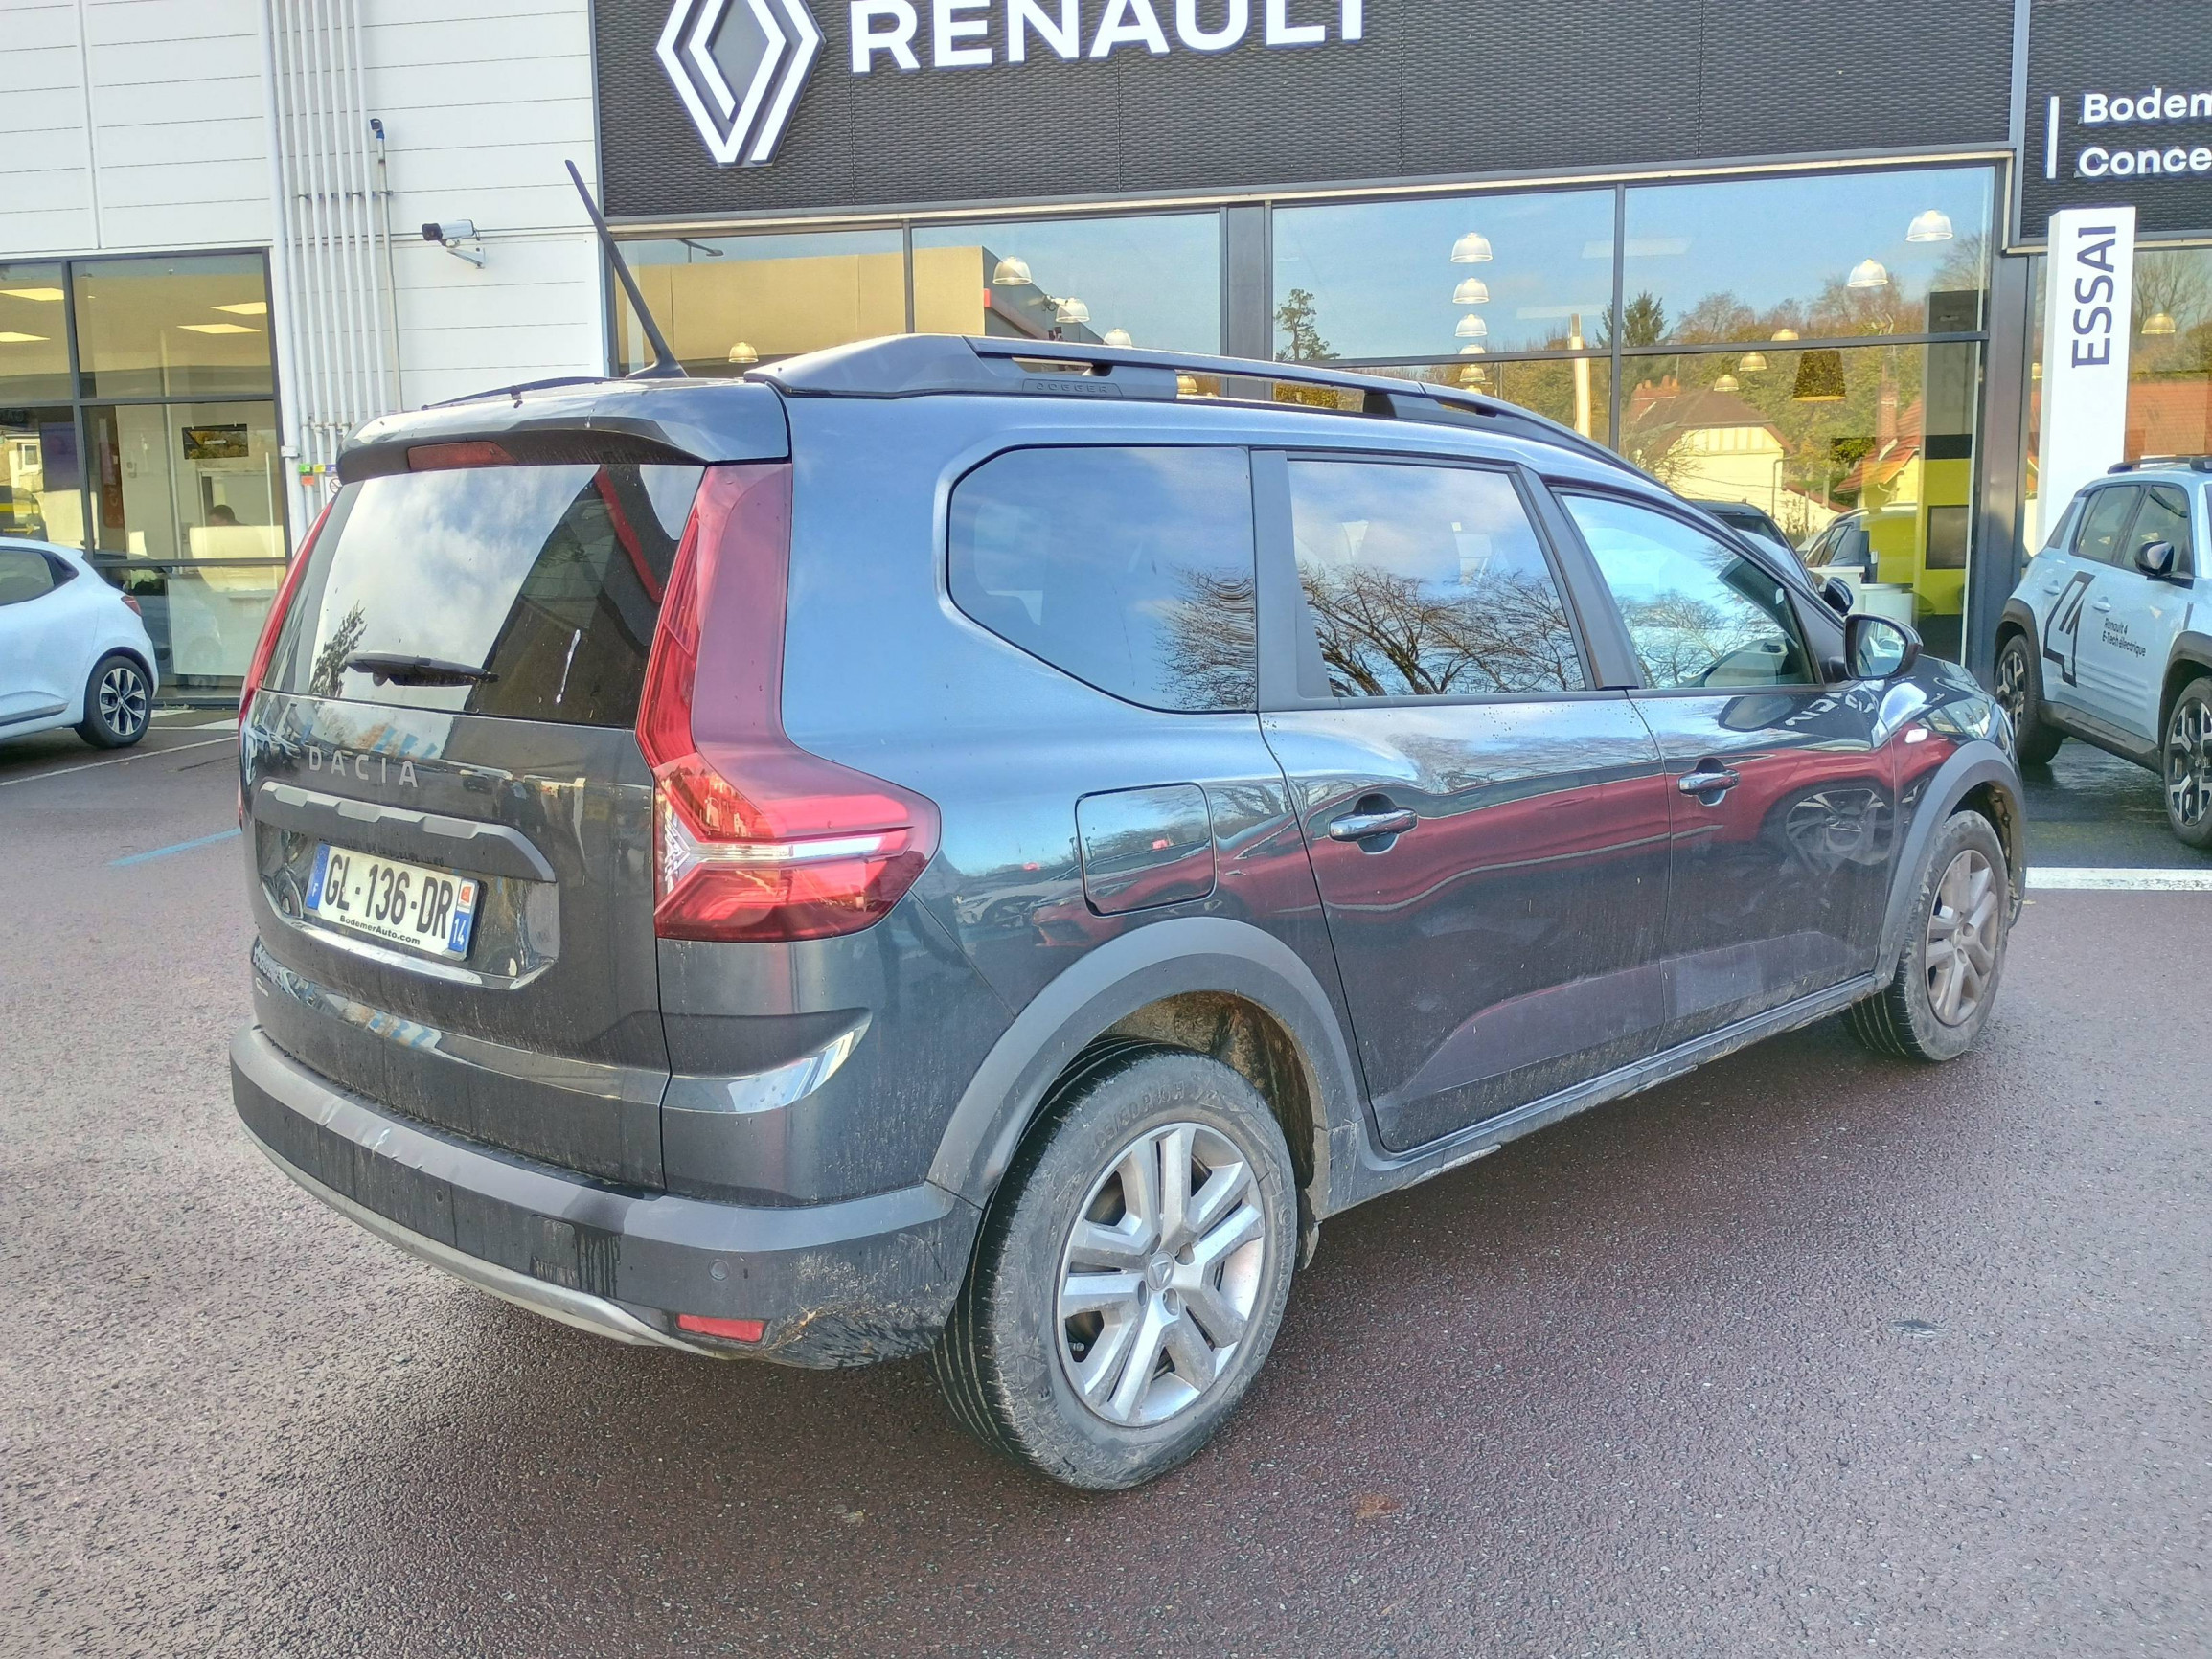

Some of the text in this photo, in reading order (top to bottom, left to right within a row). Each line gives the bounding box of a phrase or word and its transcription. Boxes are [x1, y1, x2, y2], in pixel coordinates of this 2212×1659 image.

[2078, 147, 2212, 177] Conce
[2071, 226, 2117, 368] ESSAI
[308, 746, 419, 788] DACIA
[311, 882, 319, 898] F
[339, 914, 422, 946] BodemerAuto.com
[452, 917, 466, 946] 14
